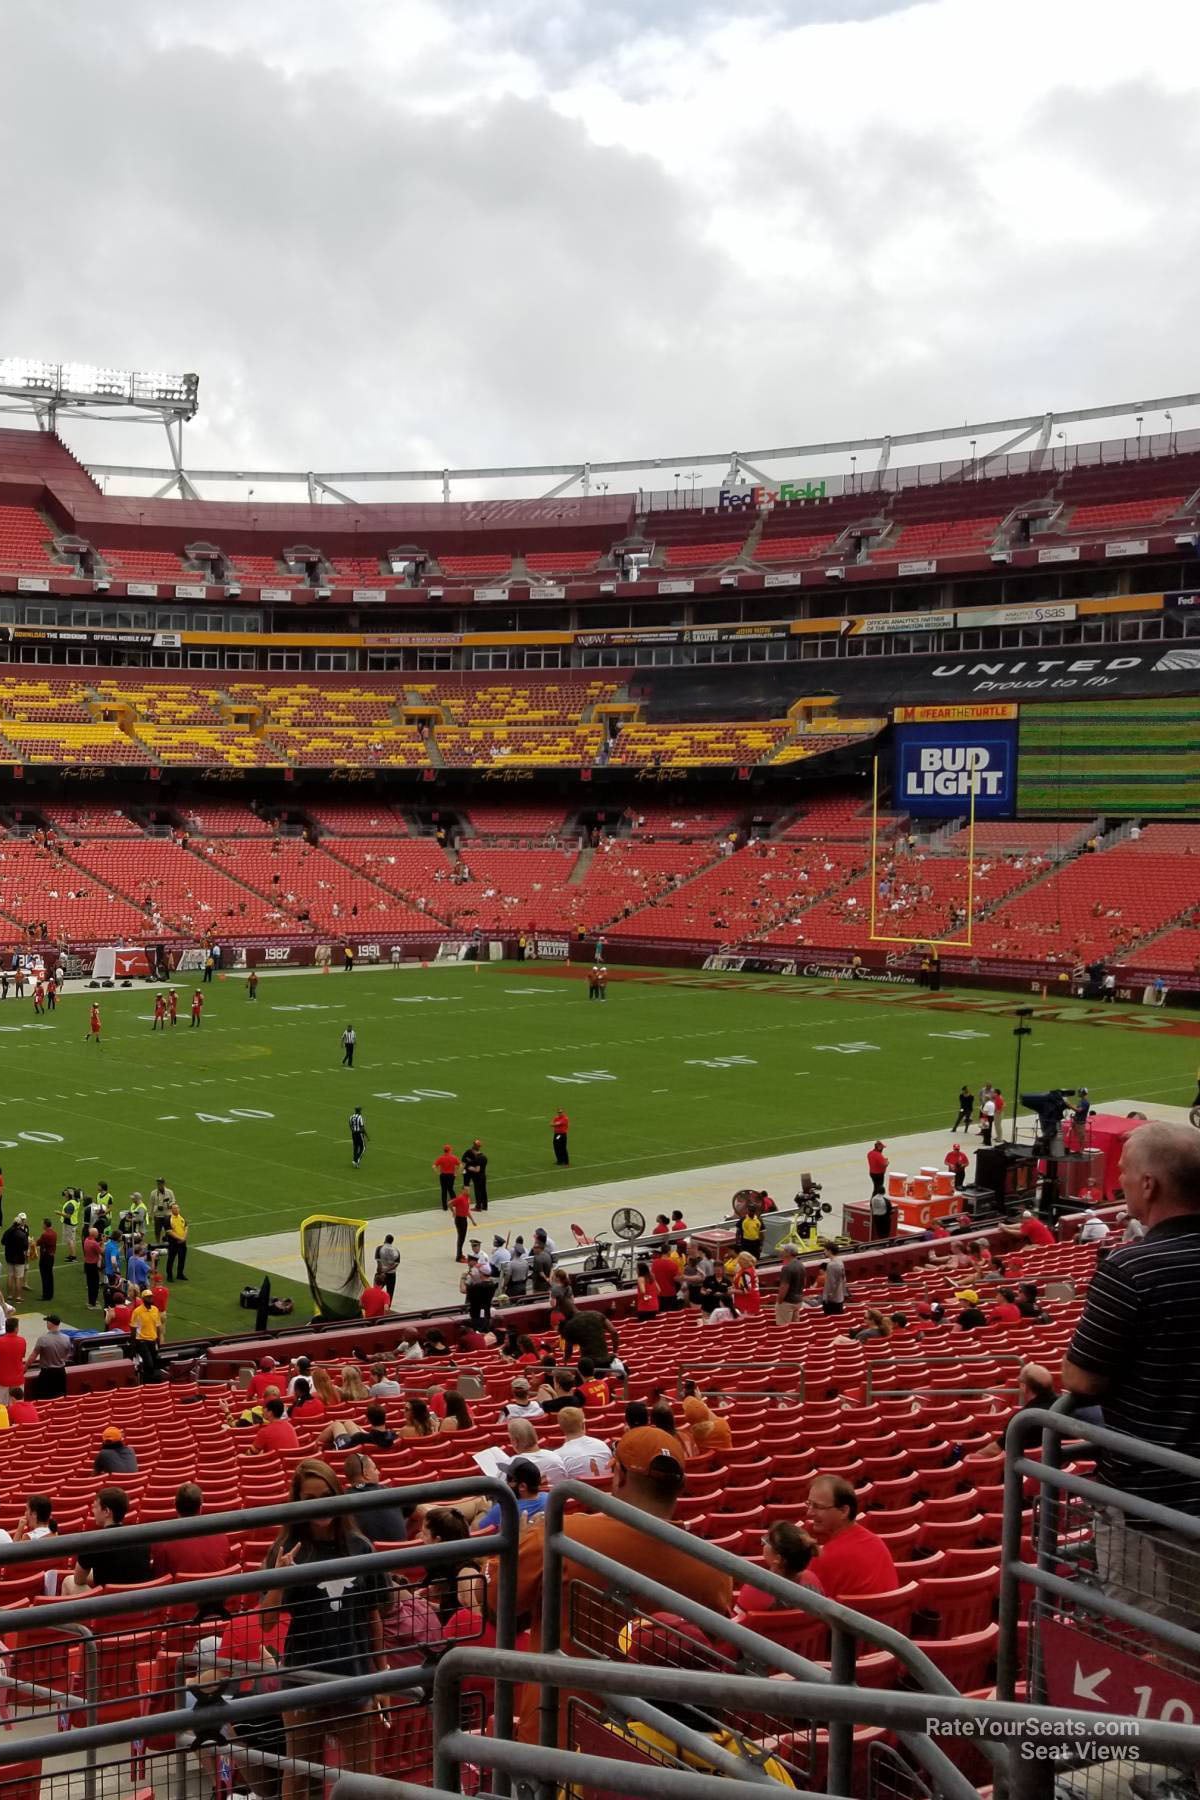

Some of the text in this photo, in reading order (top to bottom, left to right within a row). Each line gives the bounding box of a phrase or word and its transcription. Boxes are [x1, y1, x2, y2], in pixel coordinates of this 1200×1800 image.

[719, 481, 825, 507] FedExField
[1044, 608, 1066, 618] sas
[866, 619, 890, 627] OFFICIAL
[891, 617, 920, 625] ANALYTICS
[931, 657, 1143, 677] UNITED
[972, 675, 1119, 693] Proud to fly
[904, 708, 915, 719] M
[920, 747, 990, 772] BUD
[906, 771, 1003, 796] LIGHT
[264, 947, 291, 960] 1987
[357, 944, 381, 957] 1991
[538, 946, 569, 957] SALUTE
[855, 967, 916, 984] Foundation
[545, 1070, 618, 1084] 40
[372, 1088, 458, 1103] 50
[195, 1108, 276, 1124] 40
[921, 1206, 931, 1225] G
